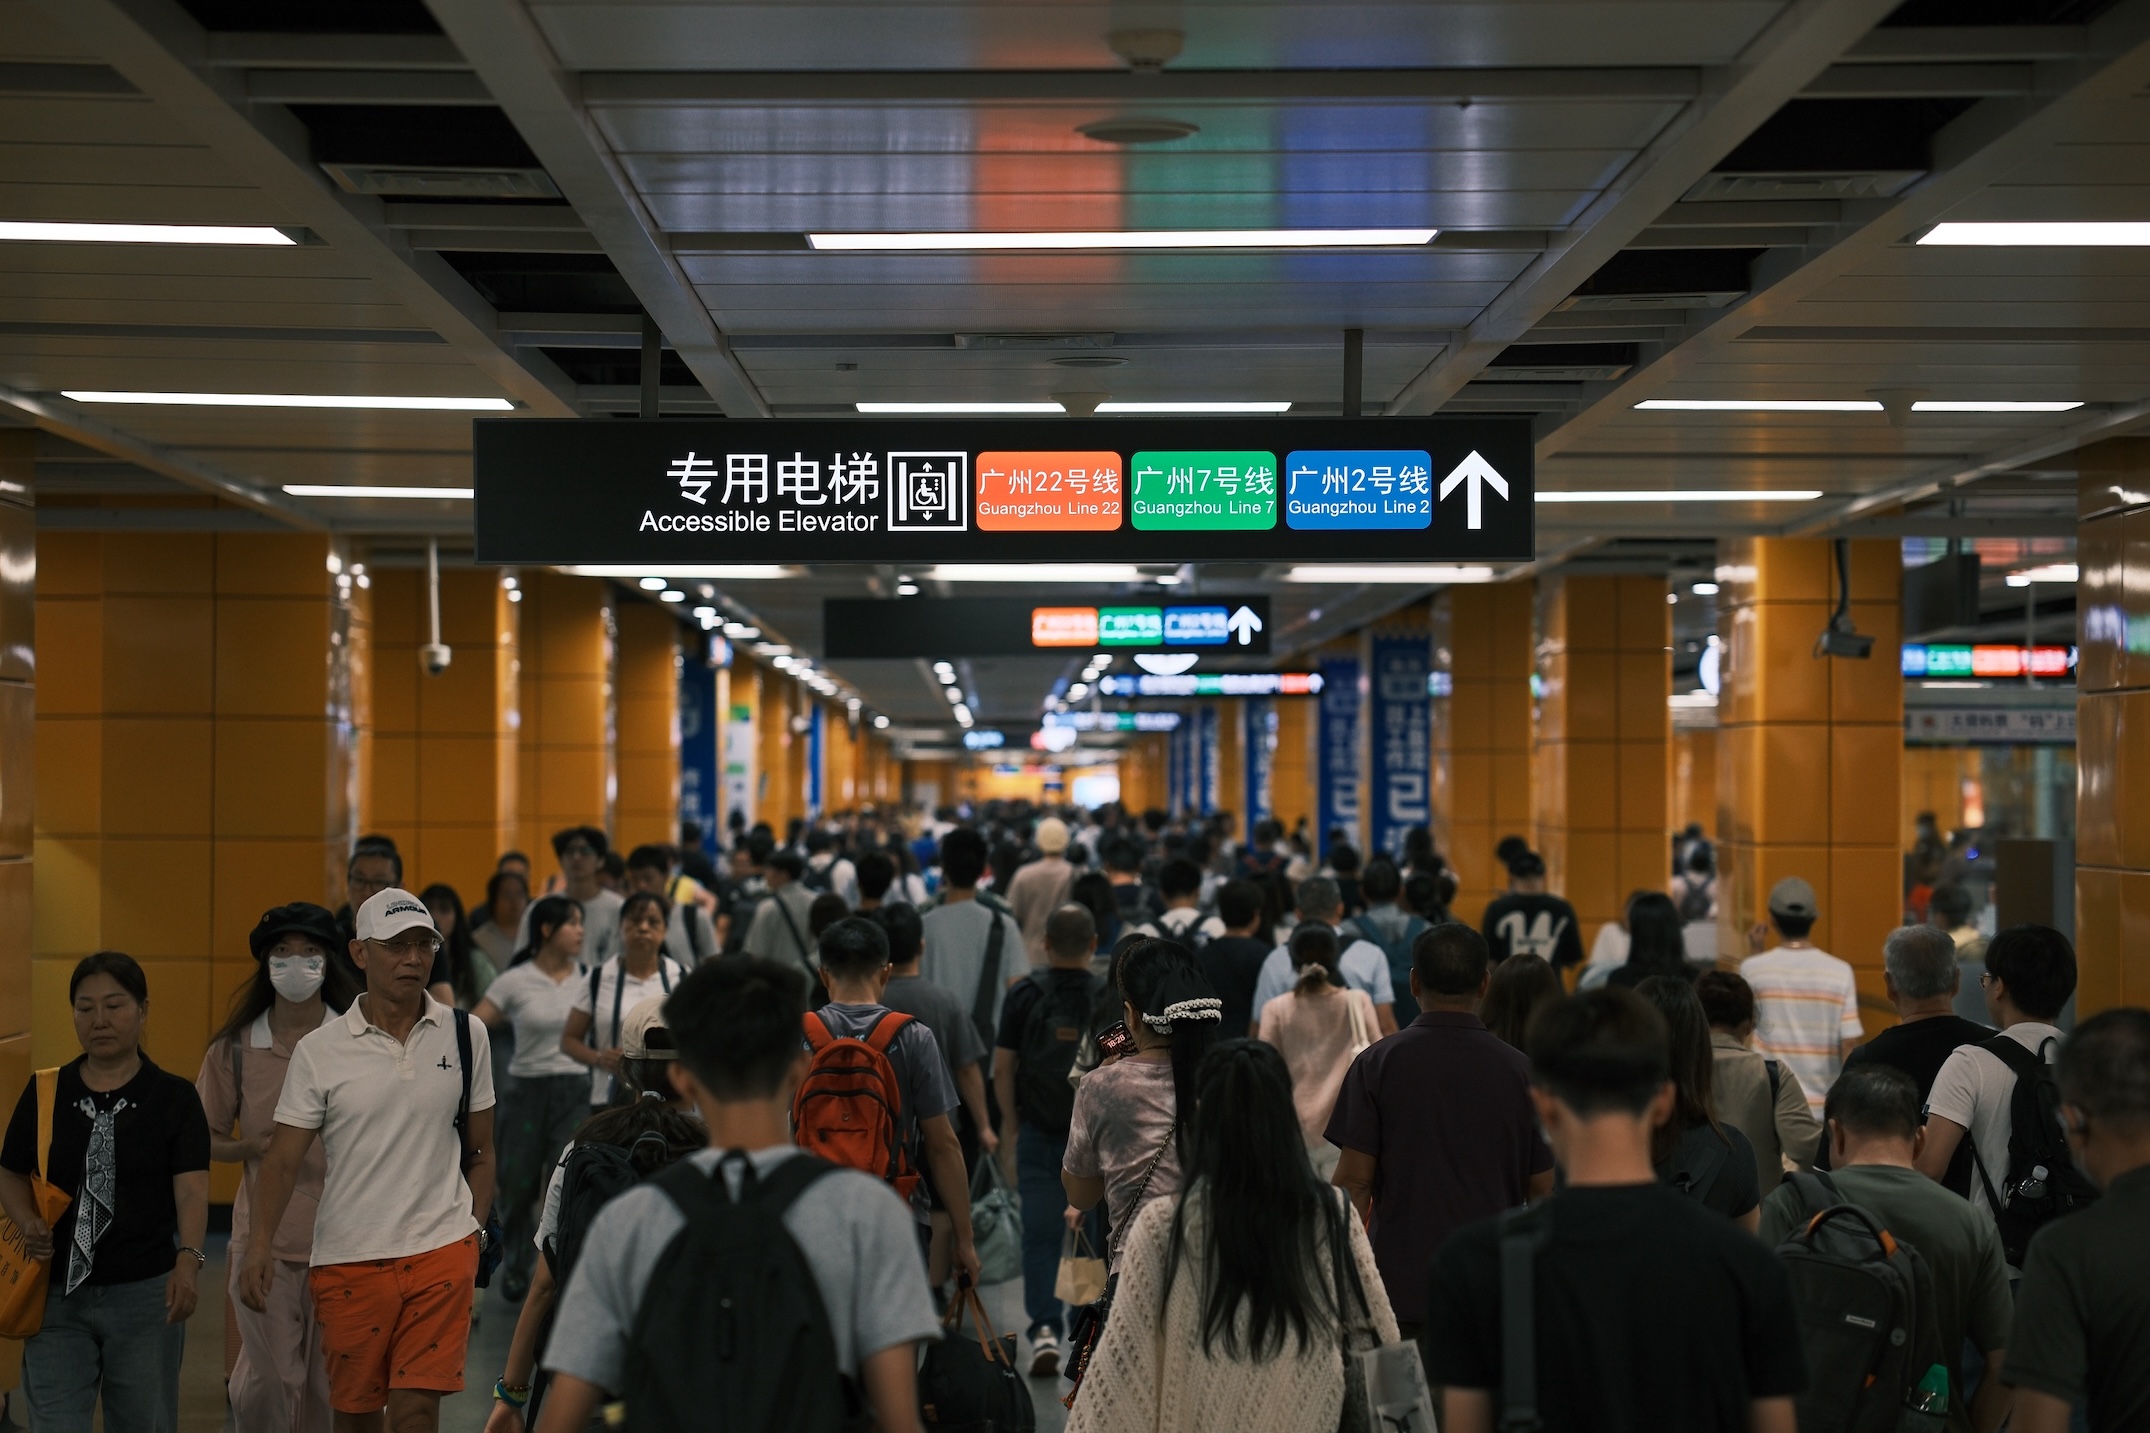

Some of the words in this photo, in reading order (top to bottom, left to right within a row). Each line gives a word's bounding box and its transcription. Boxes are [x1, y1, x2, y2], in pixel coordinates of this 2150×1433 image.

[666, 452, 880, 505] 专用电梯
[978, 467, 1120, 495] 广州22号线
[1133, 466, 1275, 495] 广州7号线
[1289, 465, 1430, 495] 广州2号线
[978, 501, 1062, 517] Guangzhou
[1068, 501, 1099, 515] Line
[1101, 501, 1120, 515] 22
[1133, 501, 1222, 517] Guangzhou
[1229, 500, 1262, 515] Line
[1266, 501, 1275, 514] 7
[1288, 500, 1377, 517] Guangzhou
[1384, 500, 1417, 514] Line
[1420, 500, 1430, 514] 2
[639, 510, 771, 532] Accessible
[778, 510, 879, 532] Elevator
[385, 905, 427, 917] ARMOUR
